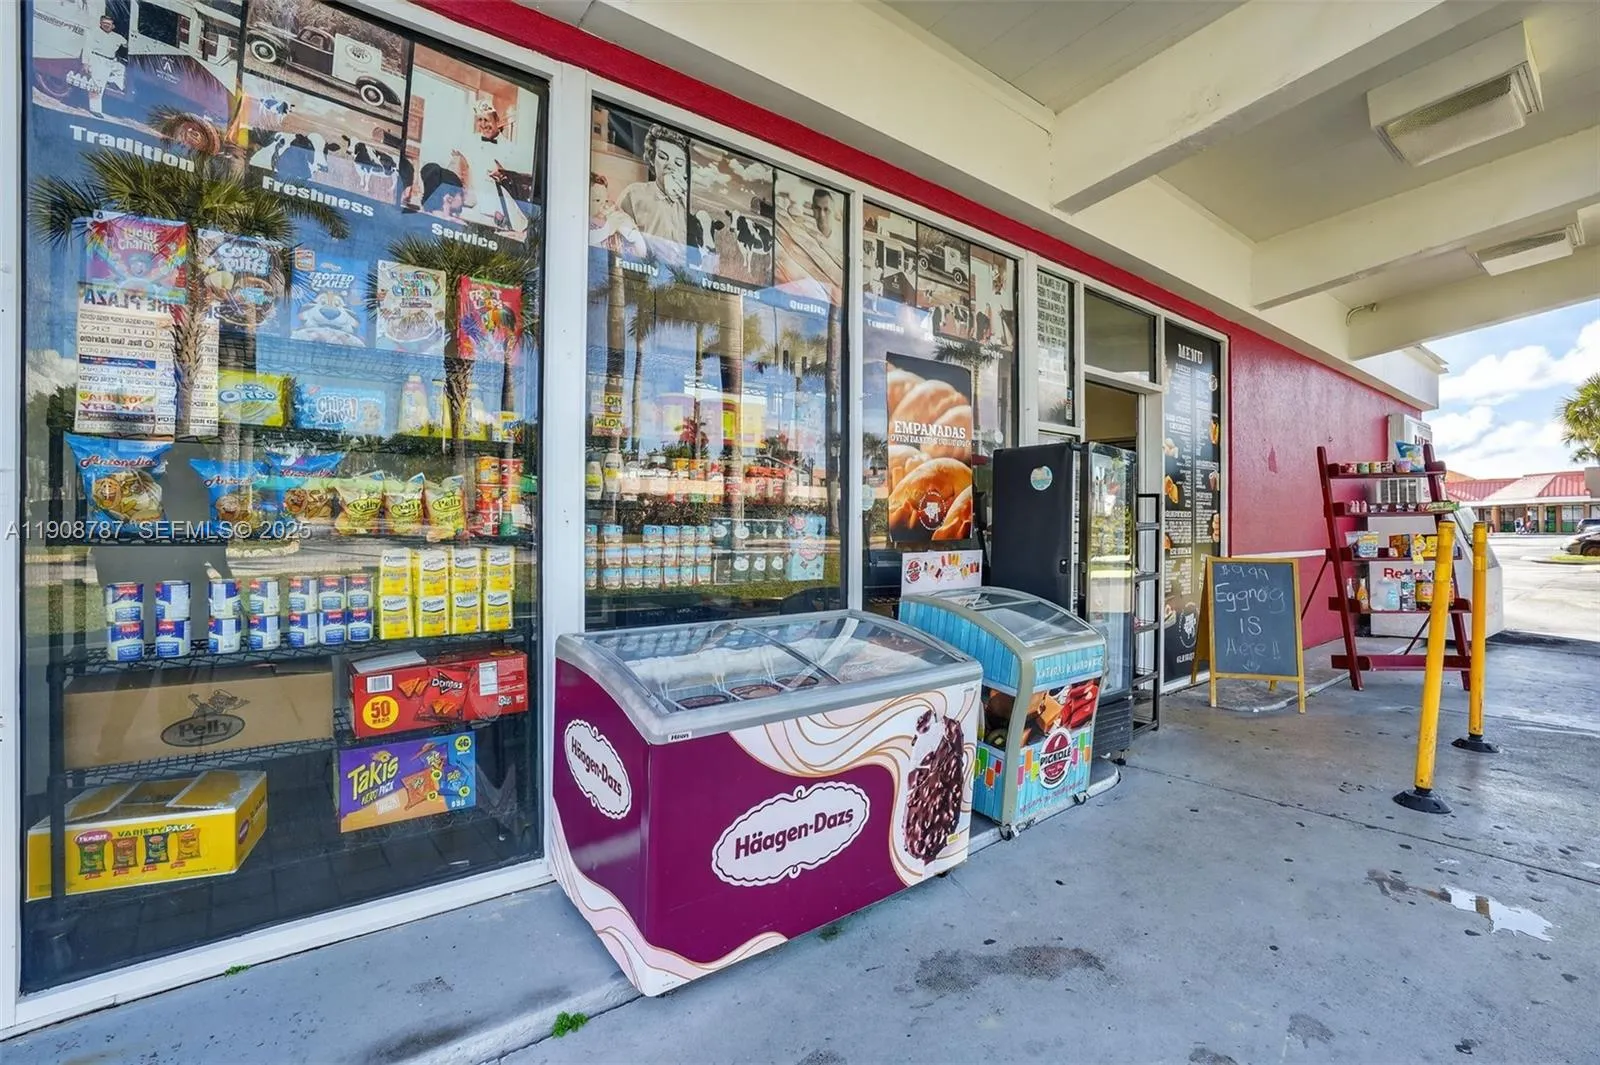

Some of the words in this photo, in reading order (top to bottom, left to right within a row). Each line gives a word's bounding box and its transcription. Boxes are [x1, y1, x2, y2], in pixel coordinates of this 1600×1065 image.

[69, 124, 196, 173] Tradition
[261, 174, 375, 217] Freshness
[431, 222, 498, 251] Service
[615, 257, 659, 278] Family
[701, 277, 761, 301] Freshness
[789, 299, 827, 317] Quality
[1178, 343, 1203, 365] MENU
[894, 420, 966, 438] EMPANADAS
[1214, 582, 1285, 613] Eggnog
[432, 678, 463, 689] Doritos
[371, 701, 391, 718] 50
[179, 720, 232, 740] Pelly
[571, 737, 622, 797] Häagen-Dazs
[348, 757, 398, 801] Takis
[165, 819, 194, 832] PACK
[735, 808, 854, 859] Häagen-Dazs
